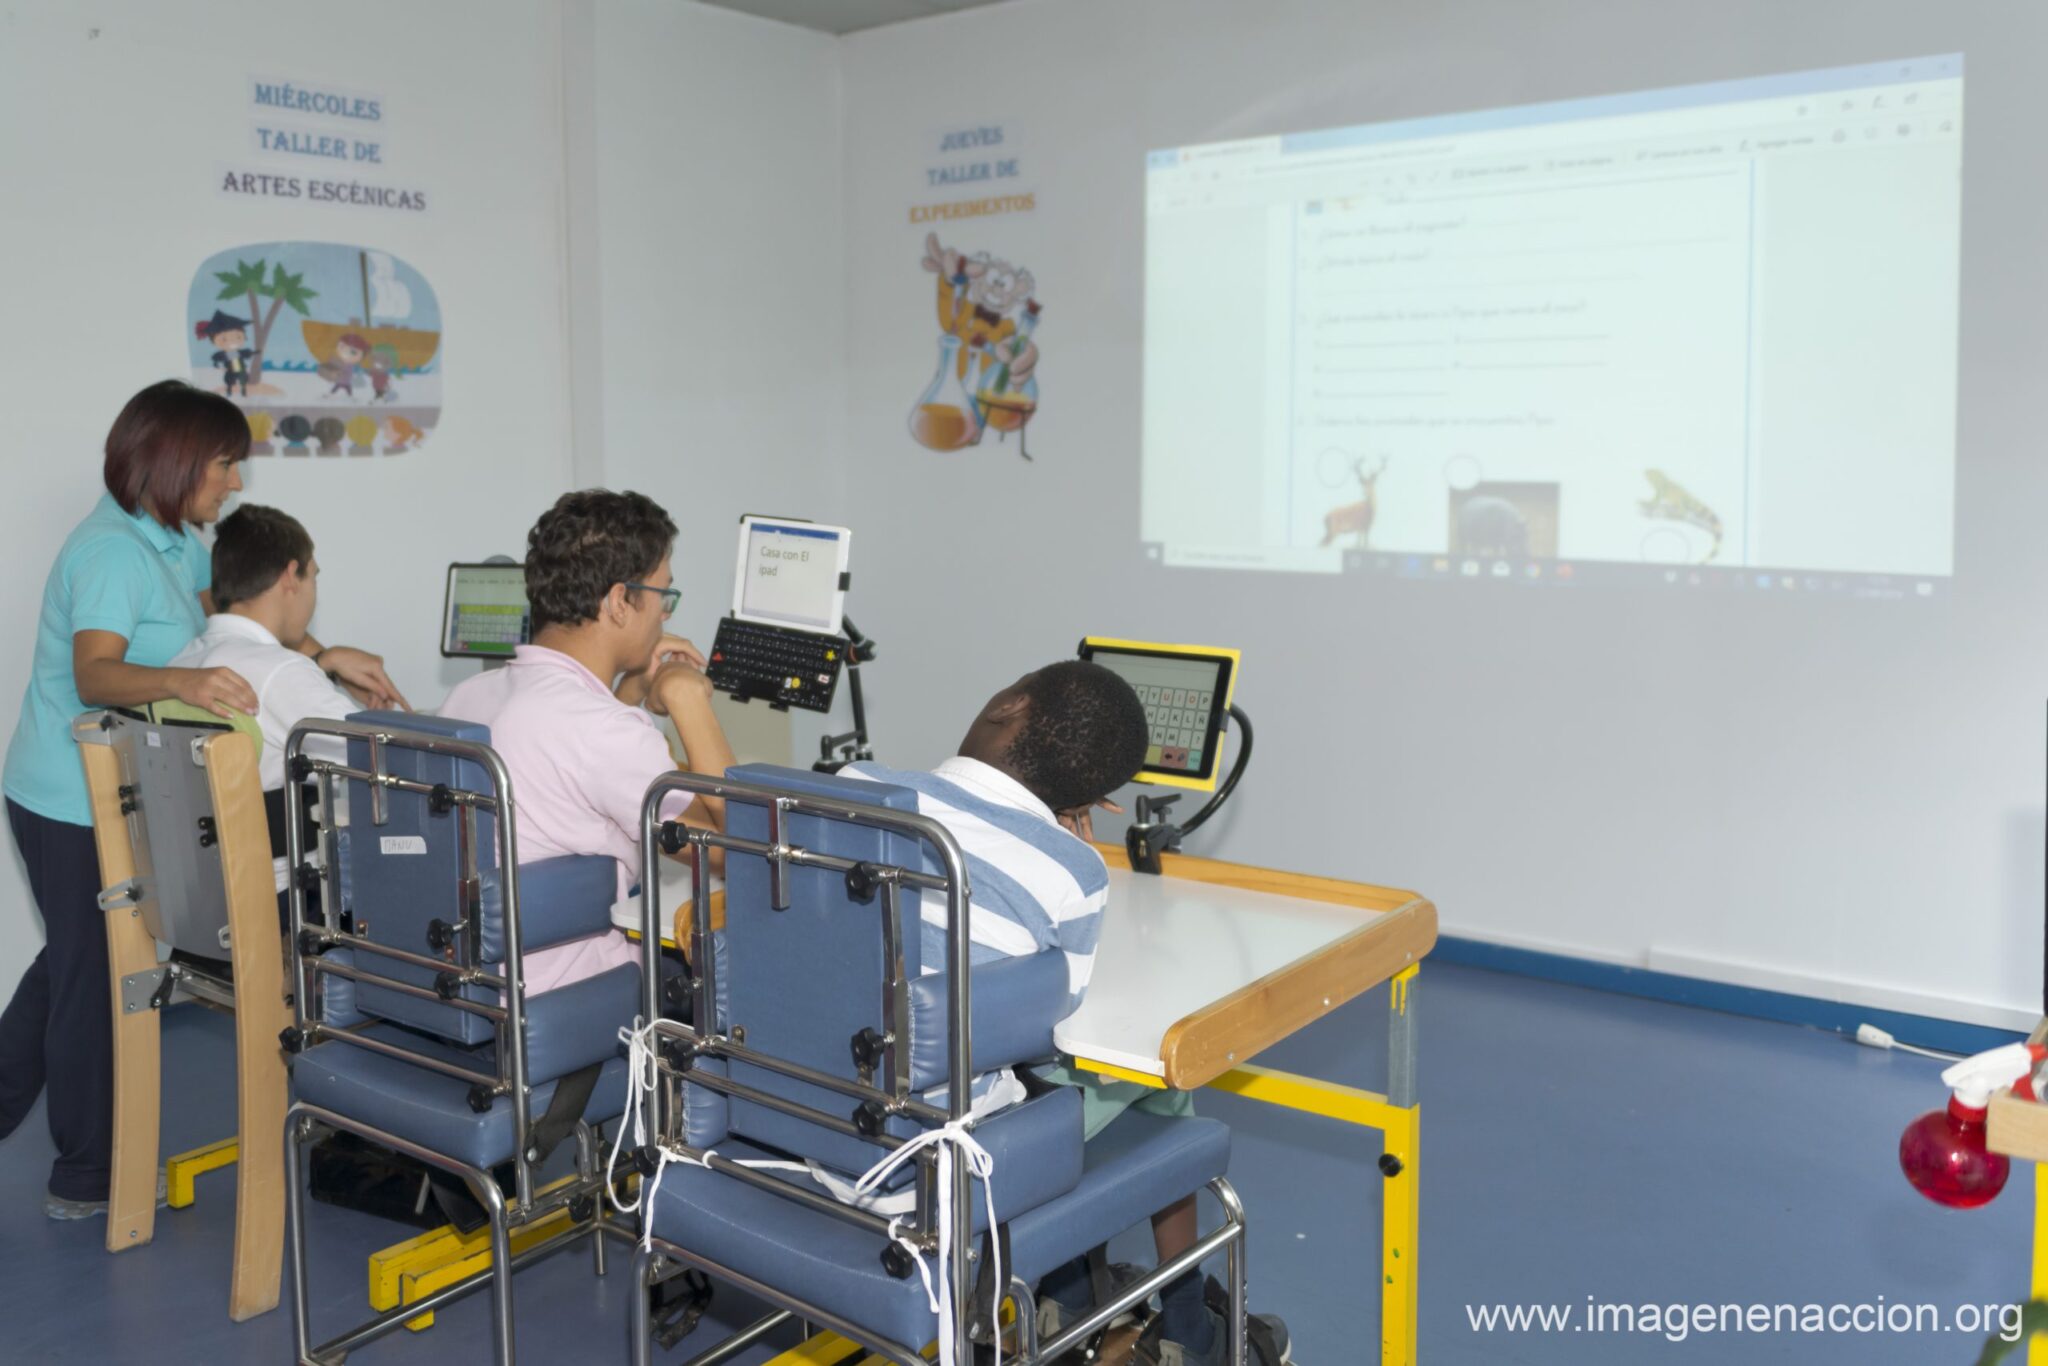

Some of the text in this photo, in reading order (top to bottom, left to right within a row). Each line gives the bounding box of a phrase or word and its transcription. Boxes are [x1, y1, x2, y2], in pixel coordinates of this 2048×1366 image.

[255, 84, 381, 121] MIÉRCOLES
[256, 127, 382, 163] TALLER DE
[941, 126, 1003, 151] JUEVES
[927, 159, 1019, 185] TALLER DE
[222, 171, 427, 212] ARTES ESCÉNICAS
[909, 192, 1035, 224] EXPERIMENTOS
[761, 546, 780, 558] Casa
[782, 551, 799, 560] con
[759, 565, 777, 577] ipad
